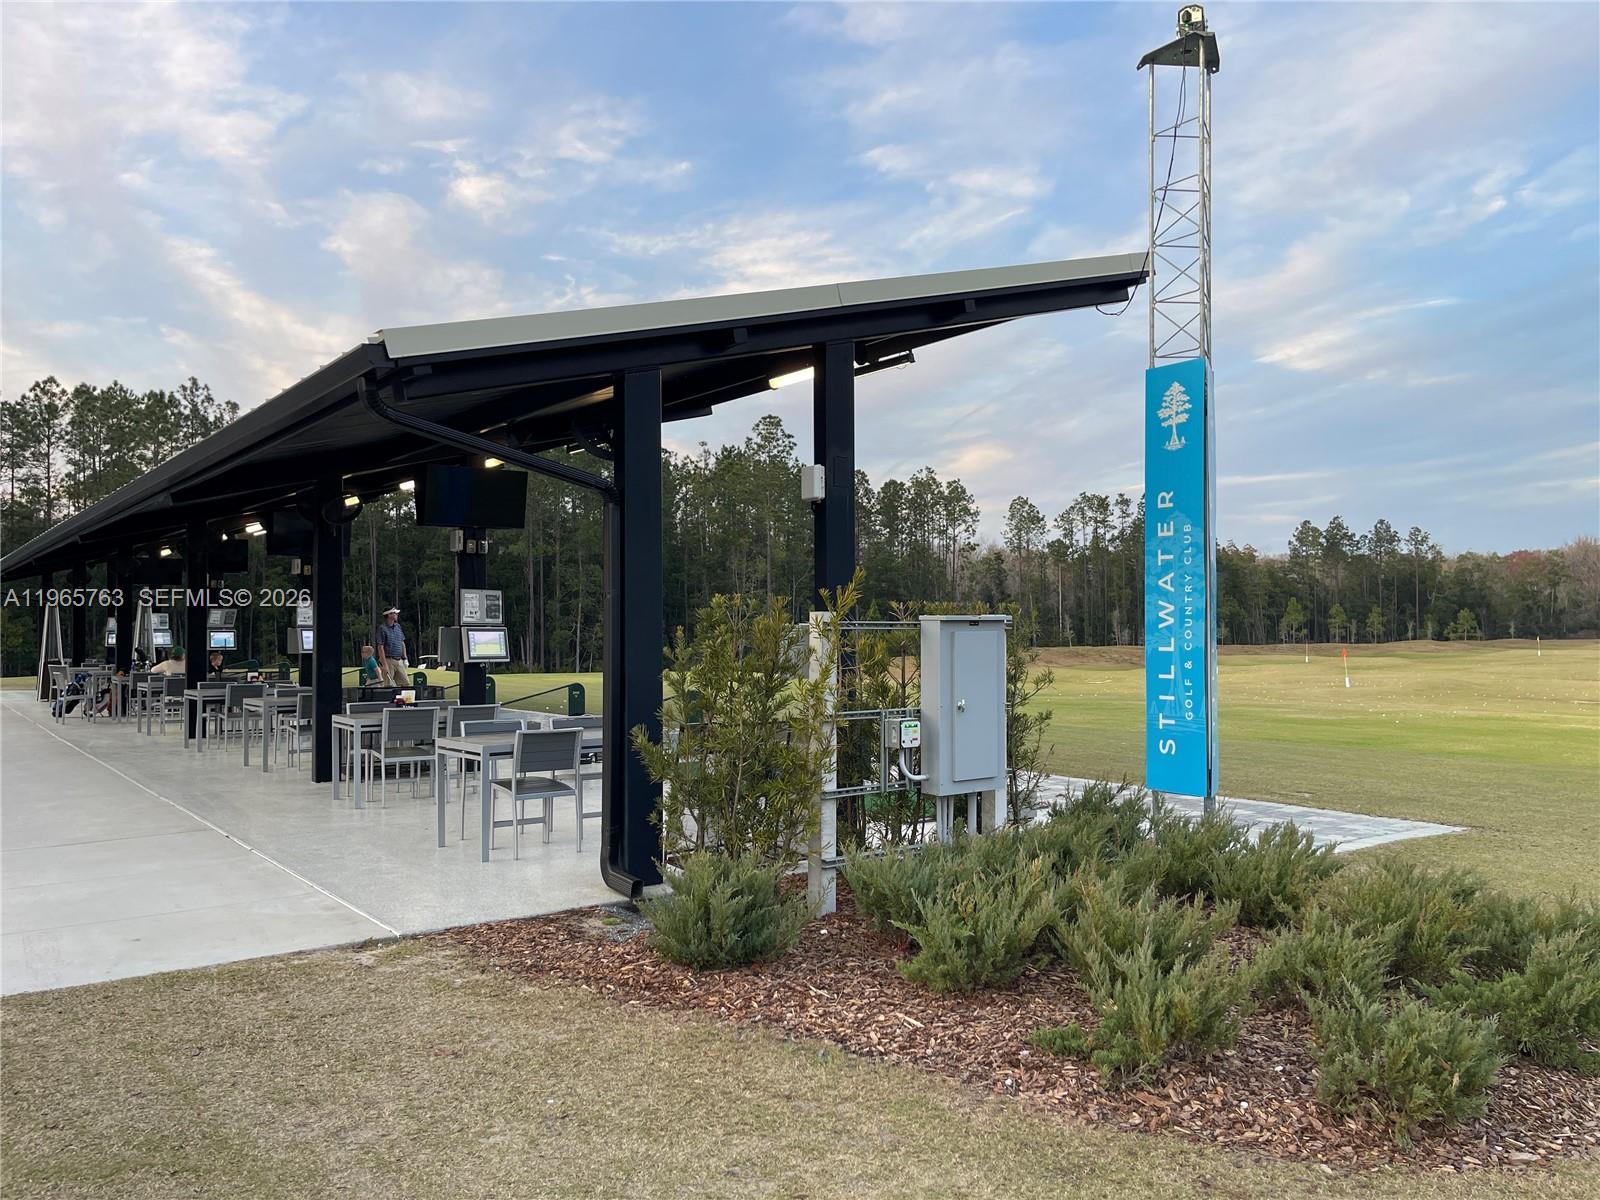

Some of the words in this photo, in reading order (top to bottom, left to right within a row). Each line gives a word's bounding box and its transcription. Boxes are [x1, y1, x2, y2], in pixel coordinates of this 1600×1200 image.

[1183, 524, 1192, 565] CLUB
[1157, 491, 1176, 756] STILLWATER
[1184, 574, 1193, 652] COUNTRY
[1184, 660, 1194, 669] &
[1184, 678, 1194, 721] GOLF
